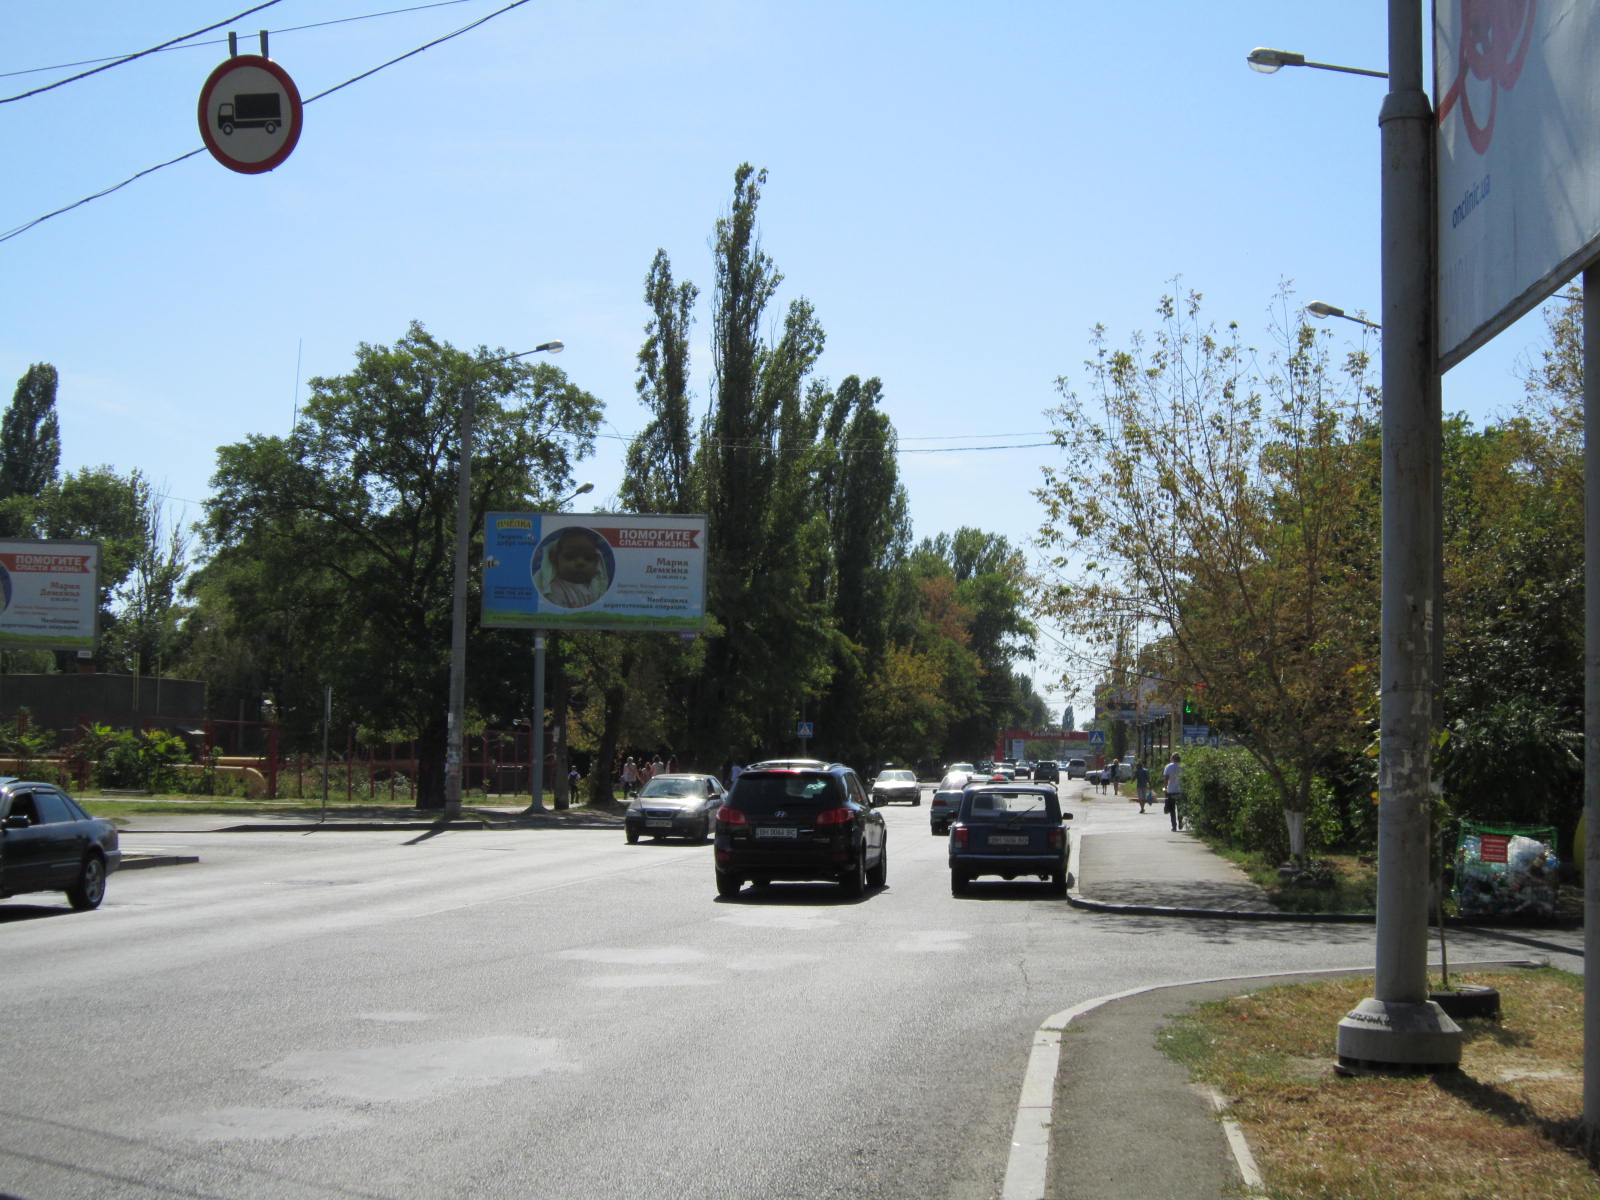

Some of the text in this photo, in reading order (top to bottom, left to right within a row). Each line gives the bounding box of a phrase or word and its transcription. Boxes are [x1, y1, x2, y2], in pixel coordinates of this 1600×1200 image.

[619, 530, 690, 540] ПОМОГИТЕ
[15, 555, 81, 566] ПОМОГИТЕ
[656, 557, 688, 567] Мария
